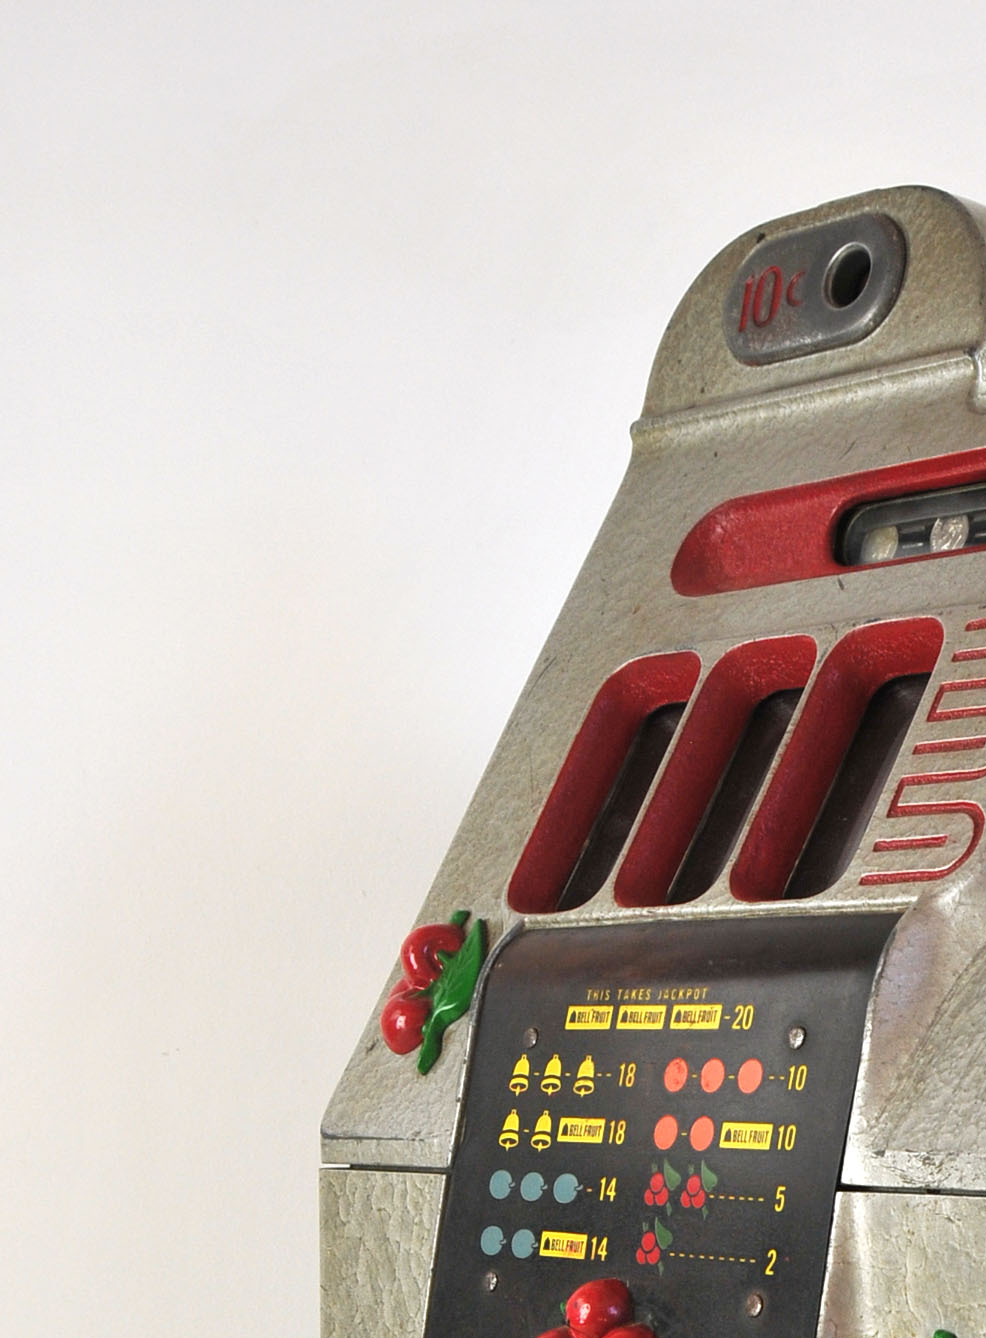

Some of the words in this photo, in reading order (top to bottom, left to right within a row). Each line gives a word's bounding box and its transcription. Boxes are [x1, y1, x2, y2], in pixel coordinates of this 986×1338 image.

[586, 989, 611, 1001] THIS
[617, 988, 651, 1000] TAKES
[657, 987, 709, 1000] JACKPOT
[576, 1010, 590, 1024] BELL
[590, 1010, 610, 1024] FRUIT
[628, 1011, 643, 1024] BELL
[643, 1011, 663, 1024] FRUIT
[681, 1010, 696, 1024] BELL
[696, 1009, 718, 1024] FRUIT
[618, 1062, 637, 1088] 18
[787, 1064, 808, 1091] 10
[569, 1124, 583, 1137] BELL
[583, 1124, 602, 1137] FRUIT
[608, 1120, 627, 1145] 18
[732, 1129, 748, 1143] BELL
[748, 1129, 770, 1144] FRUIT
[777, 1124, 797, 1151] 10
[599, 1176, 618, 1202] 14
[774, 1185, 787, 1212] 5
[551, 1238, 565, 1251] BELL
[565, 1239, 585, 1253] FRUIT
[590, 1236, 608, 1261] 14
[764, 1249, 778, 1276] 2
